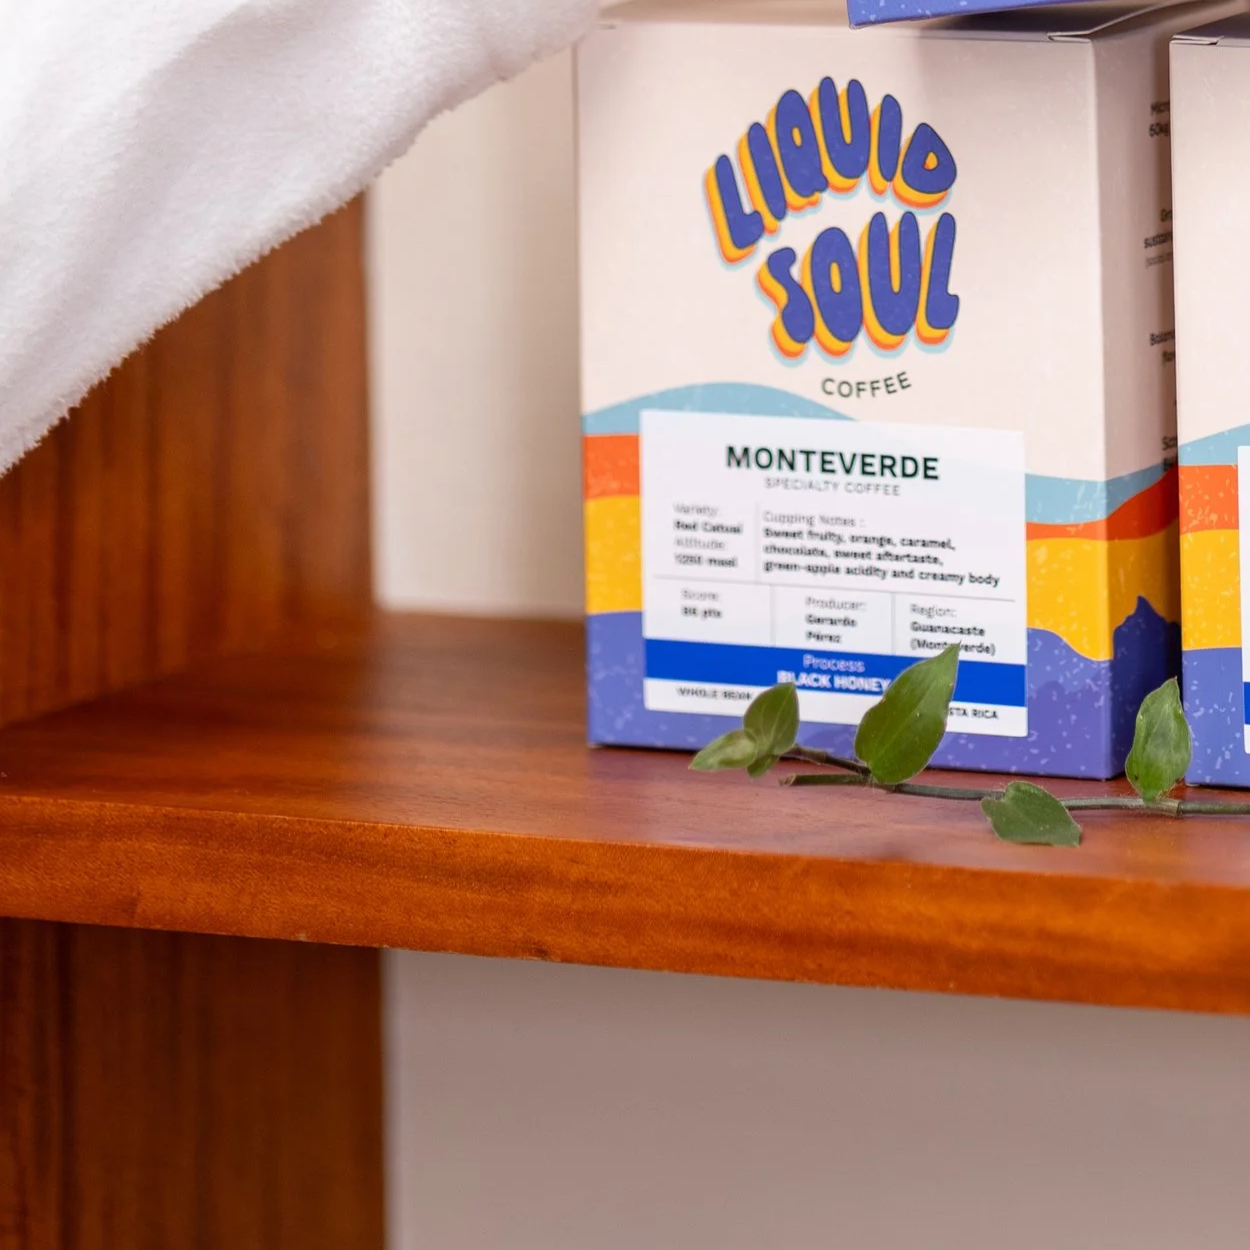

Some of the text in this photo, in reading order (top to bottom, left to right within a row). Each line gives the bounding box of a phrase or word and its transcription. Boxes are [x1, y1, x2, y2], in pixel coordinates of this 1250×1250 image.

[703, 76, 957, 267] LIQUID
[756, 211, 960, 363] SOUL
[821, 371, 912, 399] COFFEE
[725, 445, 940, 480] MONTEVERDE
[764, 476, 901, 496] SPECIALTY COFFEE
[845, 564, 887, 579] acidity
[891, 568, 915, 580] and
[918, 572, 966, 586] creamy
[968, 572, 1000, 587] body
[911, 621, 985, 637] Guanacaste
[803, 654, 865, 673] Process
[777, 670, 892, 692] BLACK HONEY
